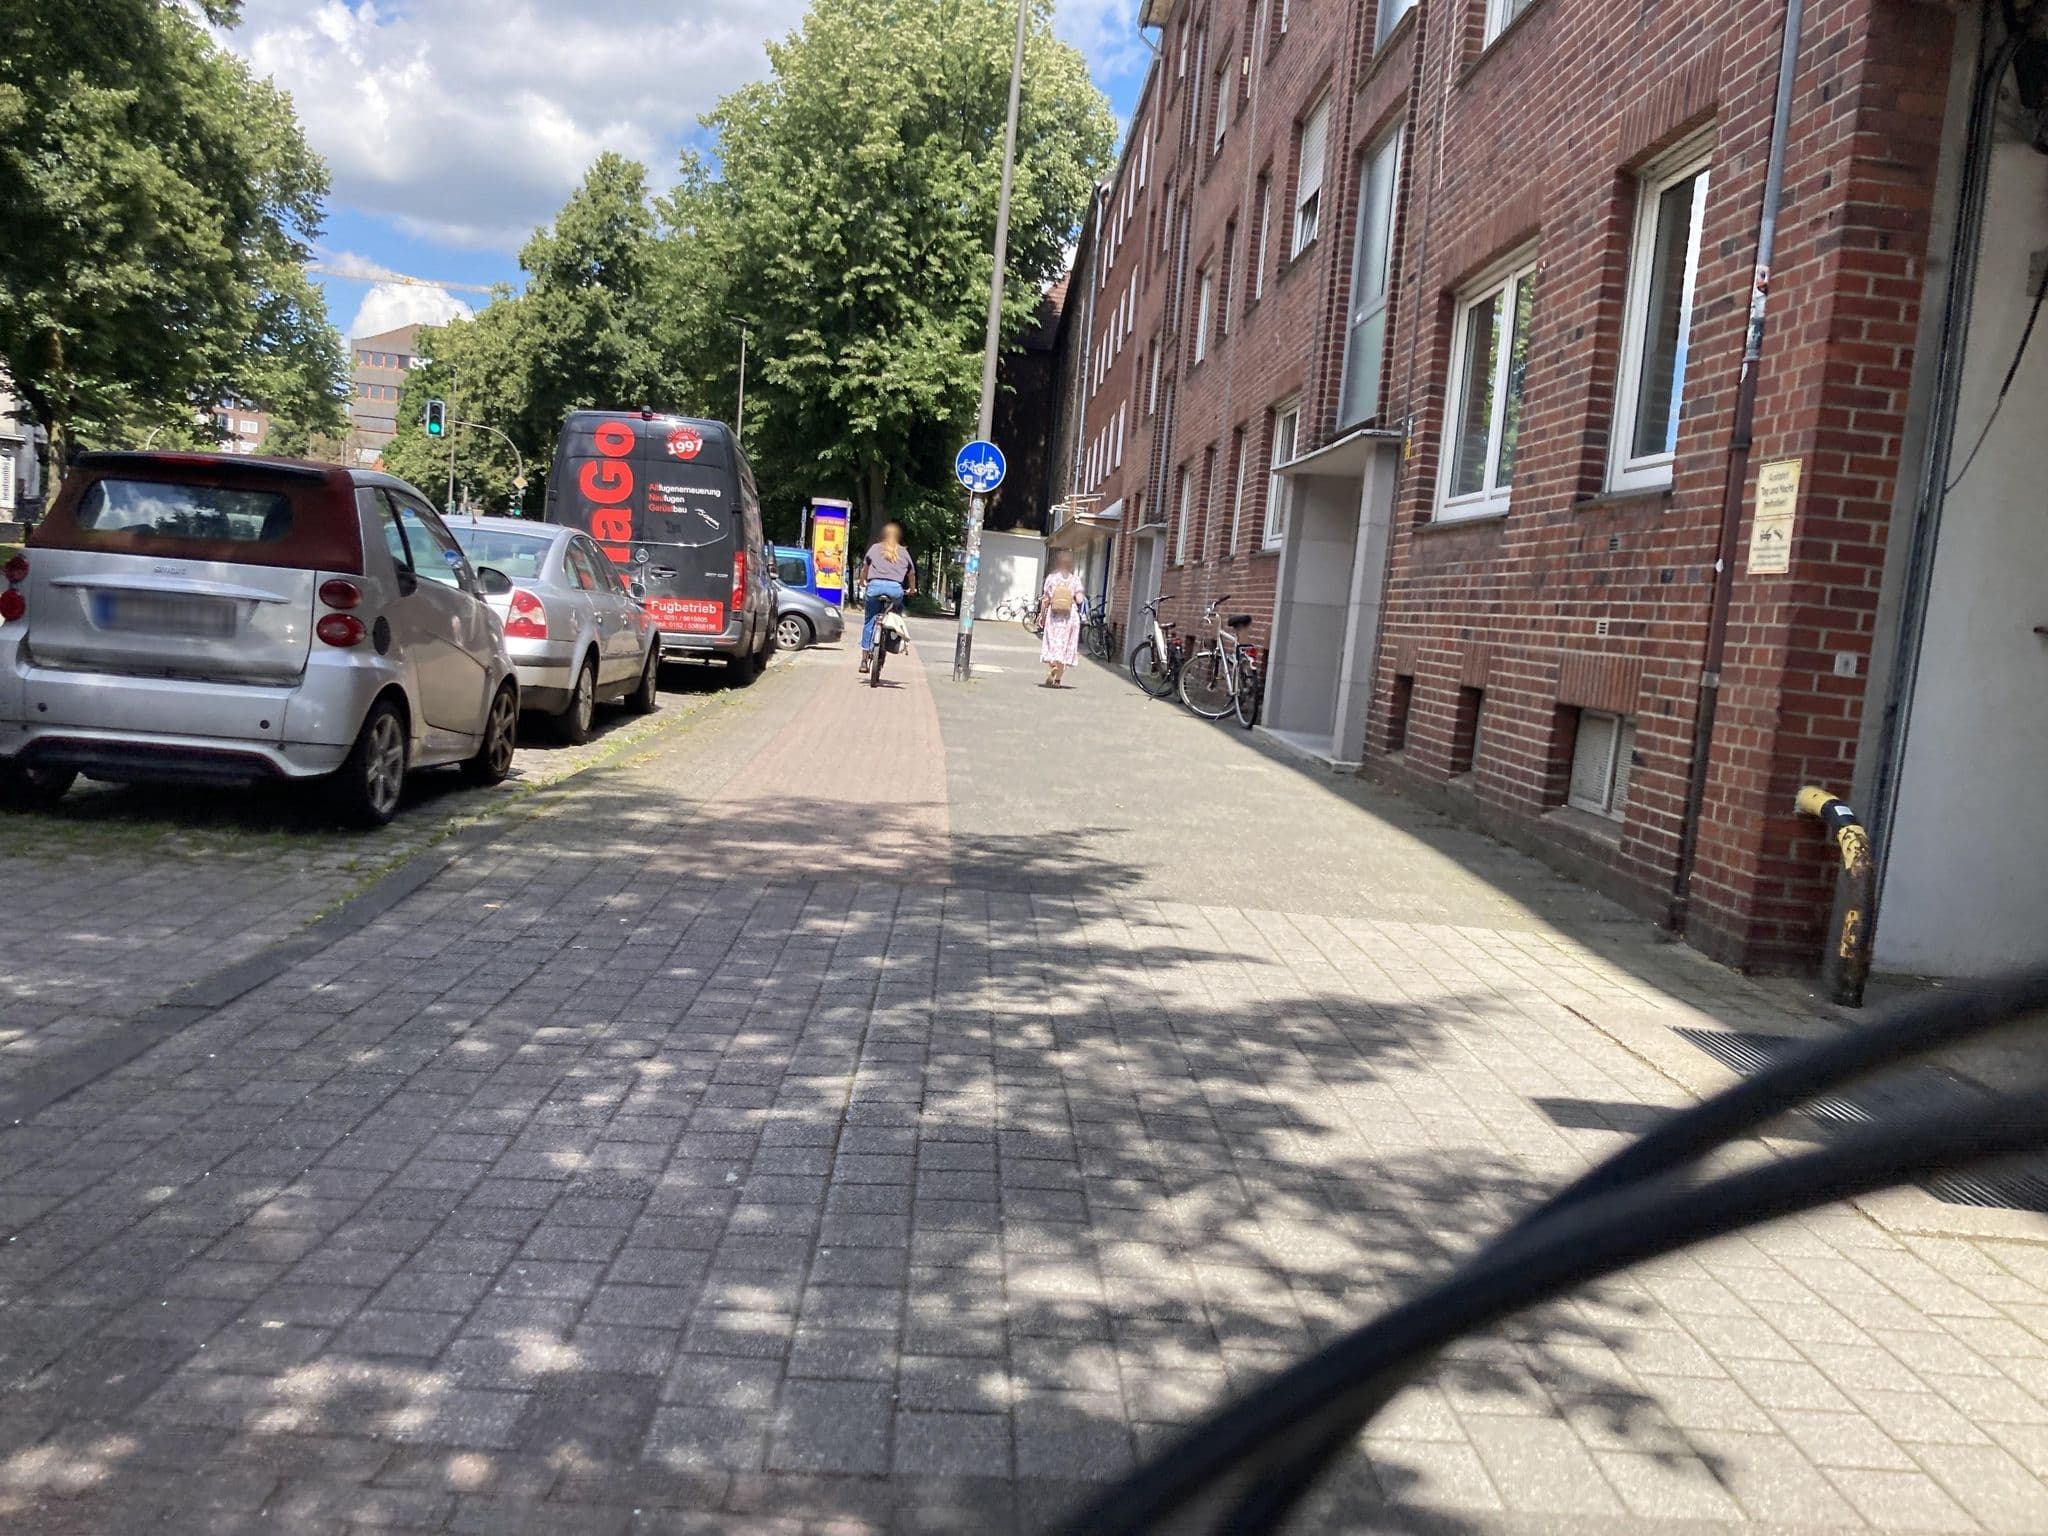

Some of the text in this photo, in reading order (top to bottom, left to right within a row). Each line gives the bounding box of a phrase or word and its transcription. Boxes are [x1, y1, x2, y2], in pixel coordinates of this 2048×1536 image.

[666, 438, 703, 455] 1997
[649, 494, 685, 504] Neufugen
[651, 600, 716, 613] Fugbetrieb
